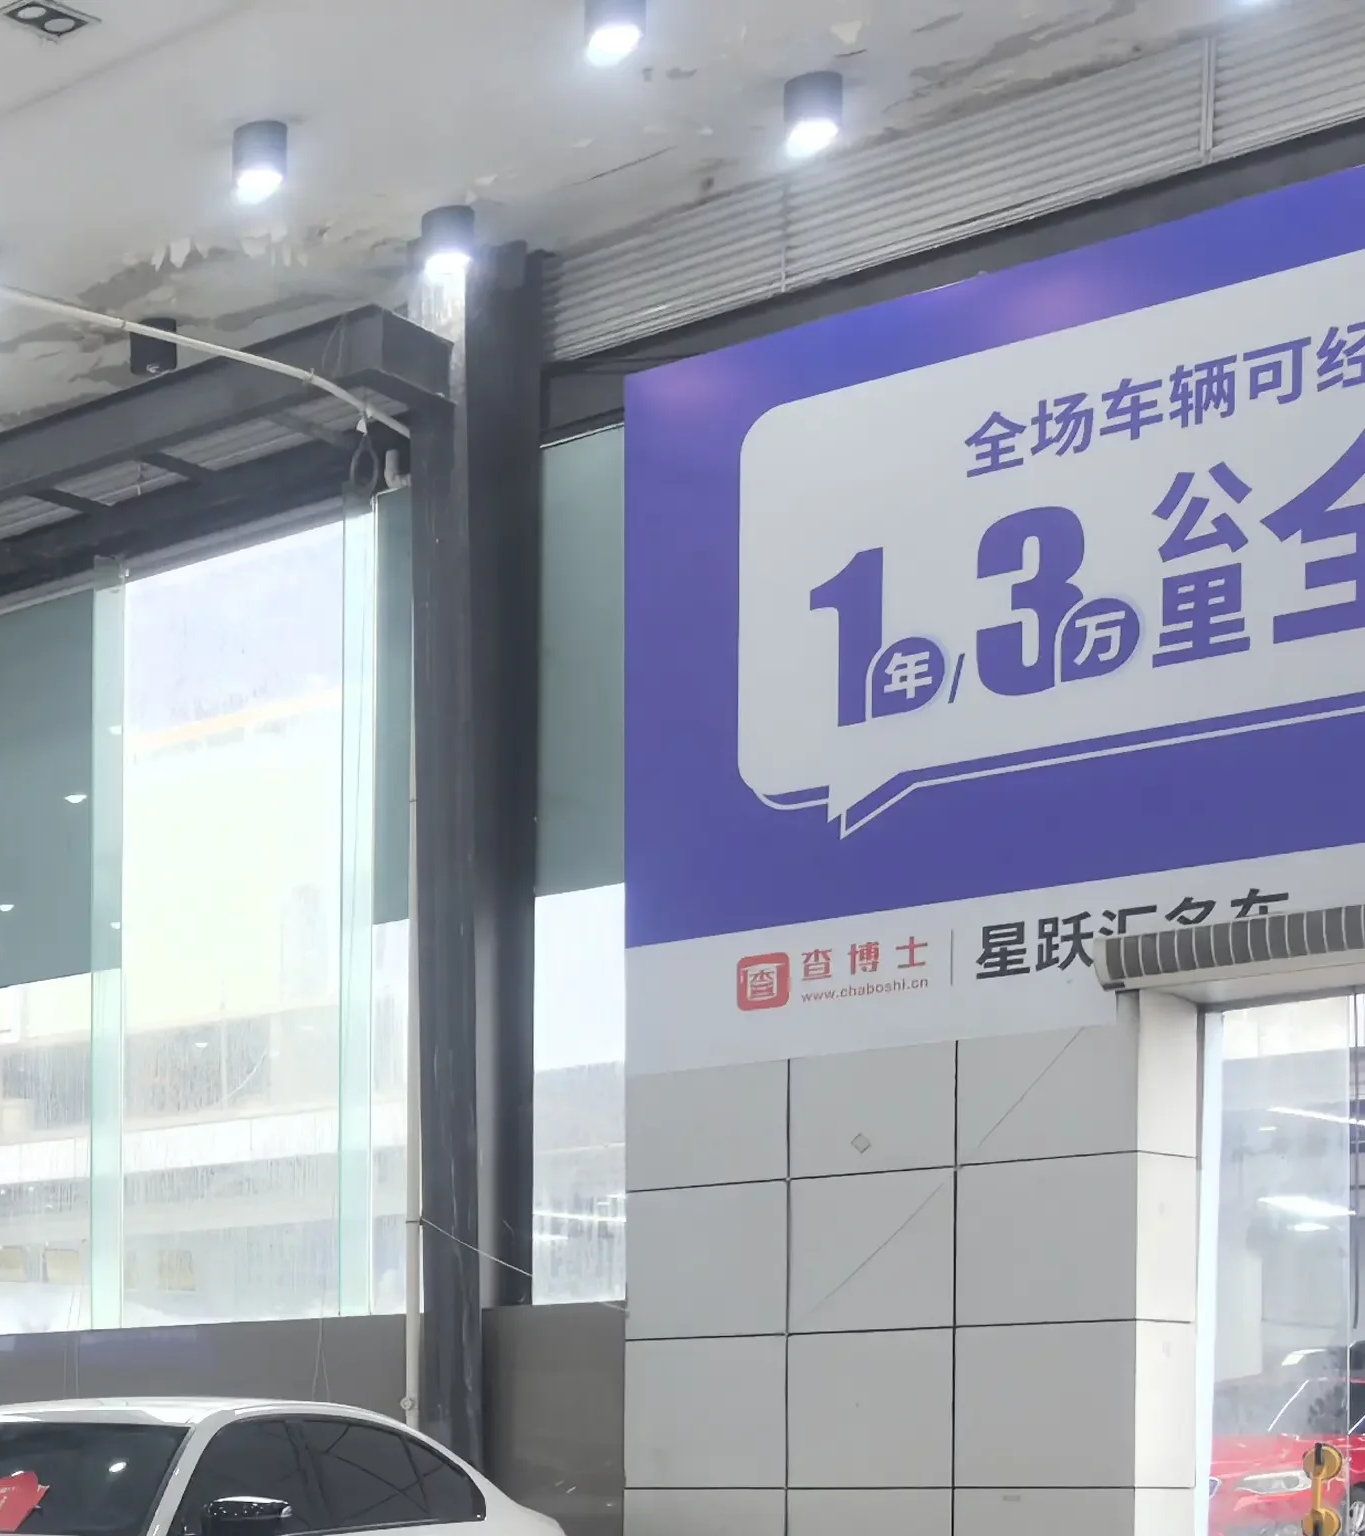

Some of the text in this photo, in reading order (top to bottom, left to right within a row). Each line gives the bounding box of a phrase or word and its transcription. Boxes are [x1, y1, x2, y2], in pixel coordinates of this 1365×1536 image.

[801, 936, 928, 982] 查博士
[801, 978, 929, 1003] www.chaboshi.cn
